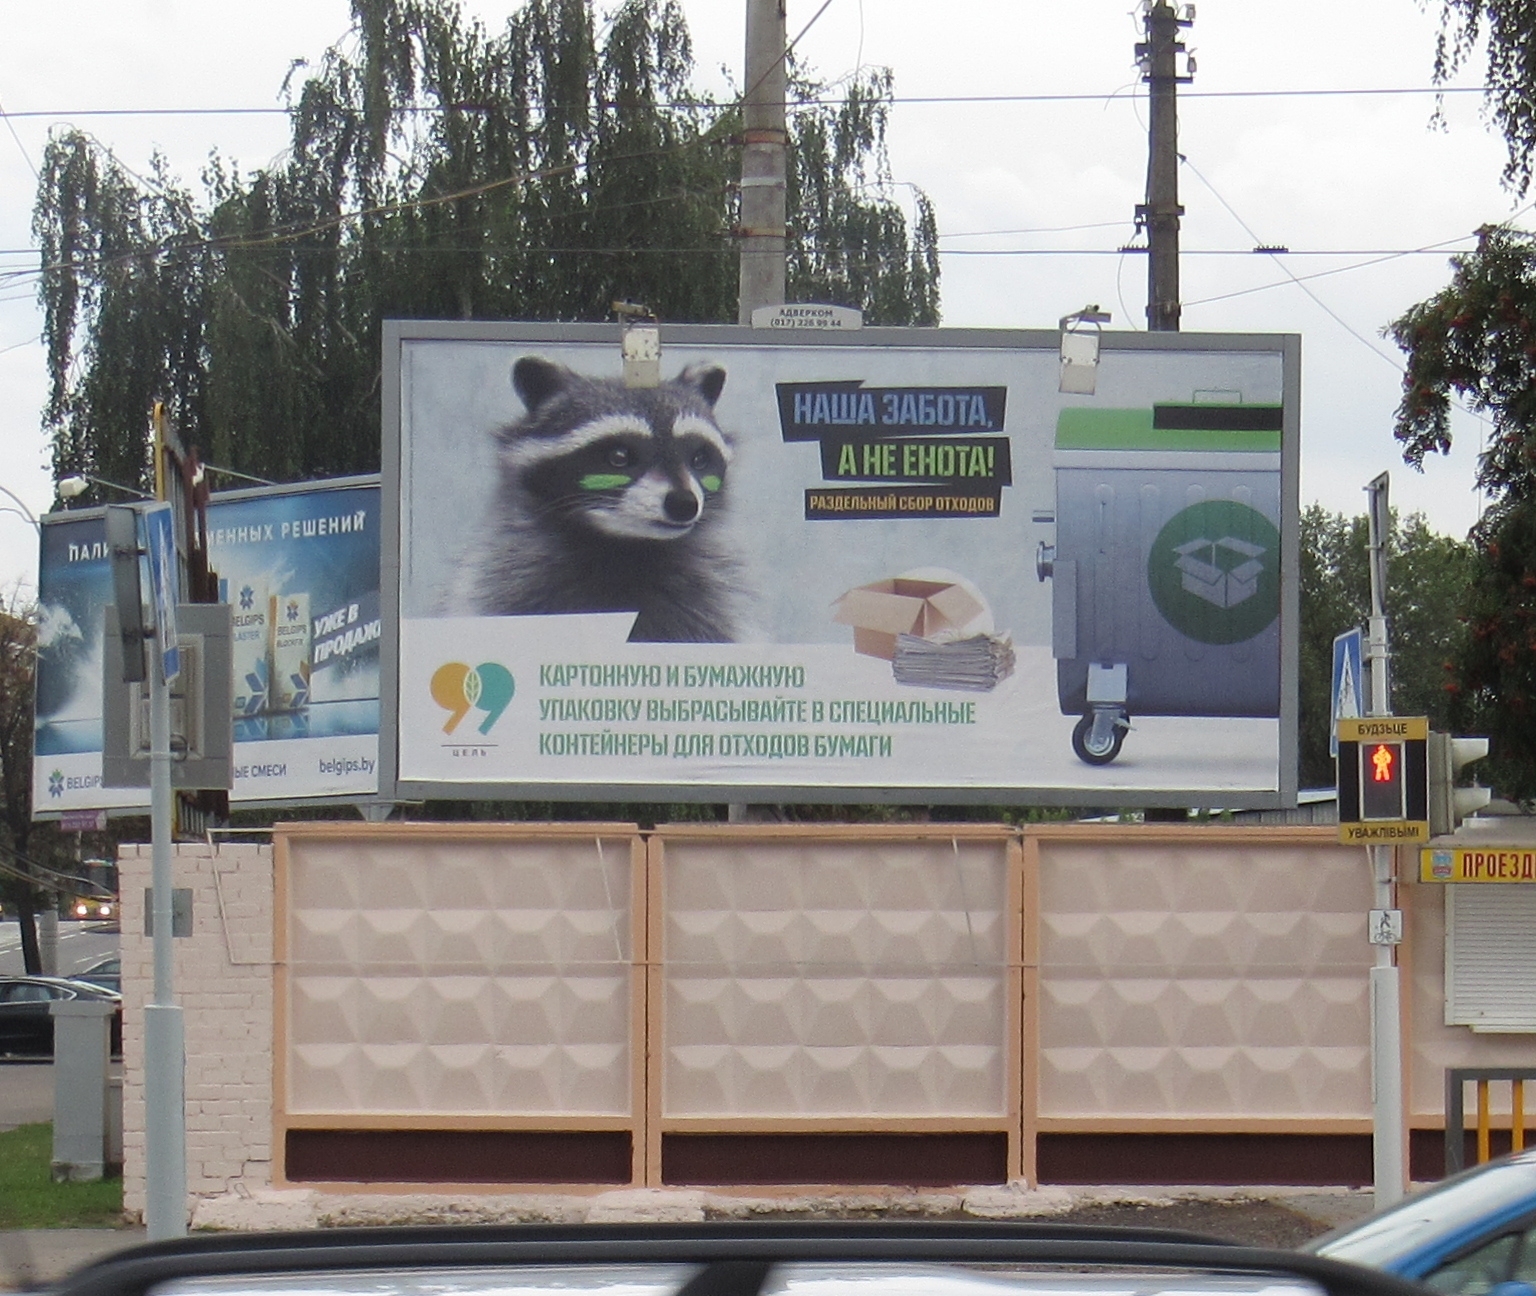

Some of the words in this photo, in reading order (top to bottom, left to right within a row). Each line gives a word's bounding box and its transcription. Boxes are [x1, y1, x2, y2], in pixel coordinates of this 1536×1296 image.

[770, 318, 795, 328] (017)
[779, 309, 833, 318] АДВЕРКОМ
[794, 393, 876, 425] НАША
[882, 394, 993, 428] ЗАБОТА,
[838, 444, 857, 476] А
[864, 444, 897, 476] НЕ
[903, 445, 995, 477] ЕНОТА!
[810, 494, 897, 511] РАЗДЕЛЬНЫЙ
[899, 496, 932, 511] СБОР
[936, 497, 994, 513] ОТХОДОВ
[68, 542, 109, 562] ПАЛИ
[282, 510, 366, 539] РЕШЕНИЙ
[313, 608, 347, 640] УЖЕ
[347, 603, 360, 625] В
[539, 664, 661, 687] КАРТОННУЮ
[667, 665, 679, 687] И
[684, 665, 804, 688] БУМАЖНУЮ
[539, 699, 641, 722] УПАКОВКУ
[647, 696, 807, 723] ВЫБРАСЫВАЙТЕ
[811, 700, 824, 723] В
[829, 701, 976, 725] СПЕЦИАЛЬНЫЕ
[1358, 723, 1408, 736] БУДЗЬЦЕ
[452, 749, 487, 757] ЦЕЛЬ
[539, 729, 669, 756] КОНТЕЙНЕРЫ
[673, 733, 713, 758] ДЛЯ
[719, 733, 809, 759] ОТХОДОВ
[814, 734, 892, 757] БУМАГИ
[251, 763, 287, 777] СМЕСИ
[319, 757, 375, 776] belgips.by
[1348, 826, 1419, 839] УВАЖЛІВЫМІ
